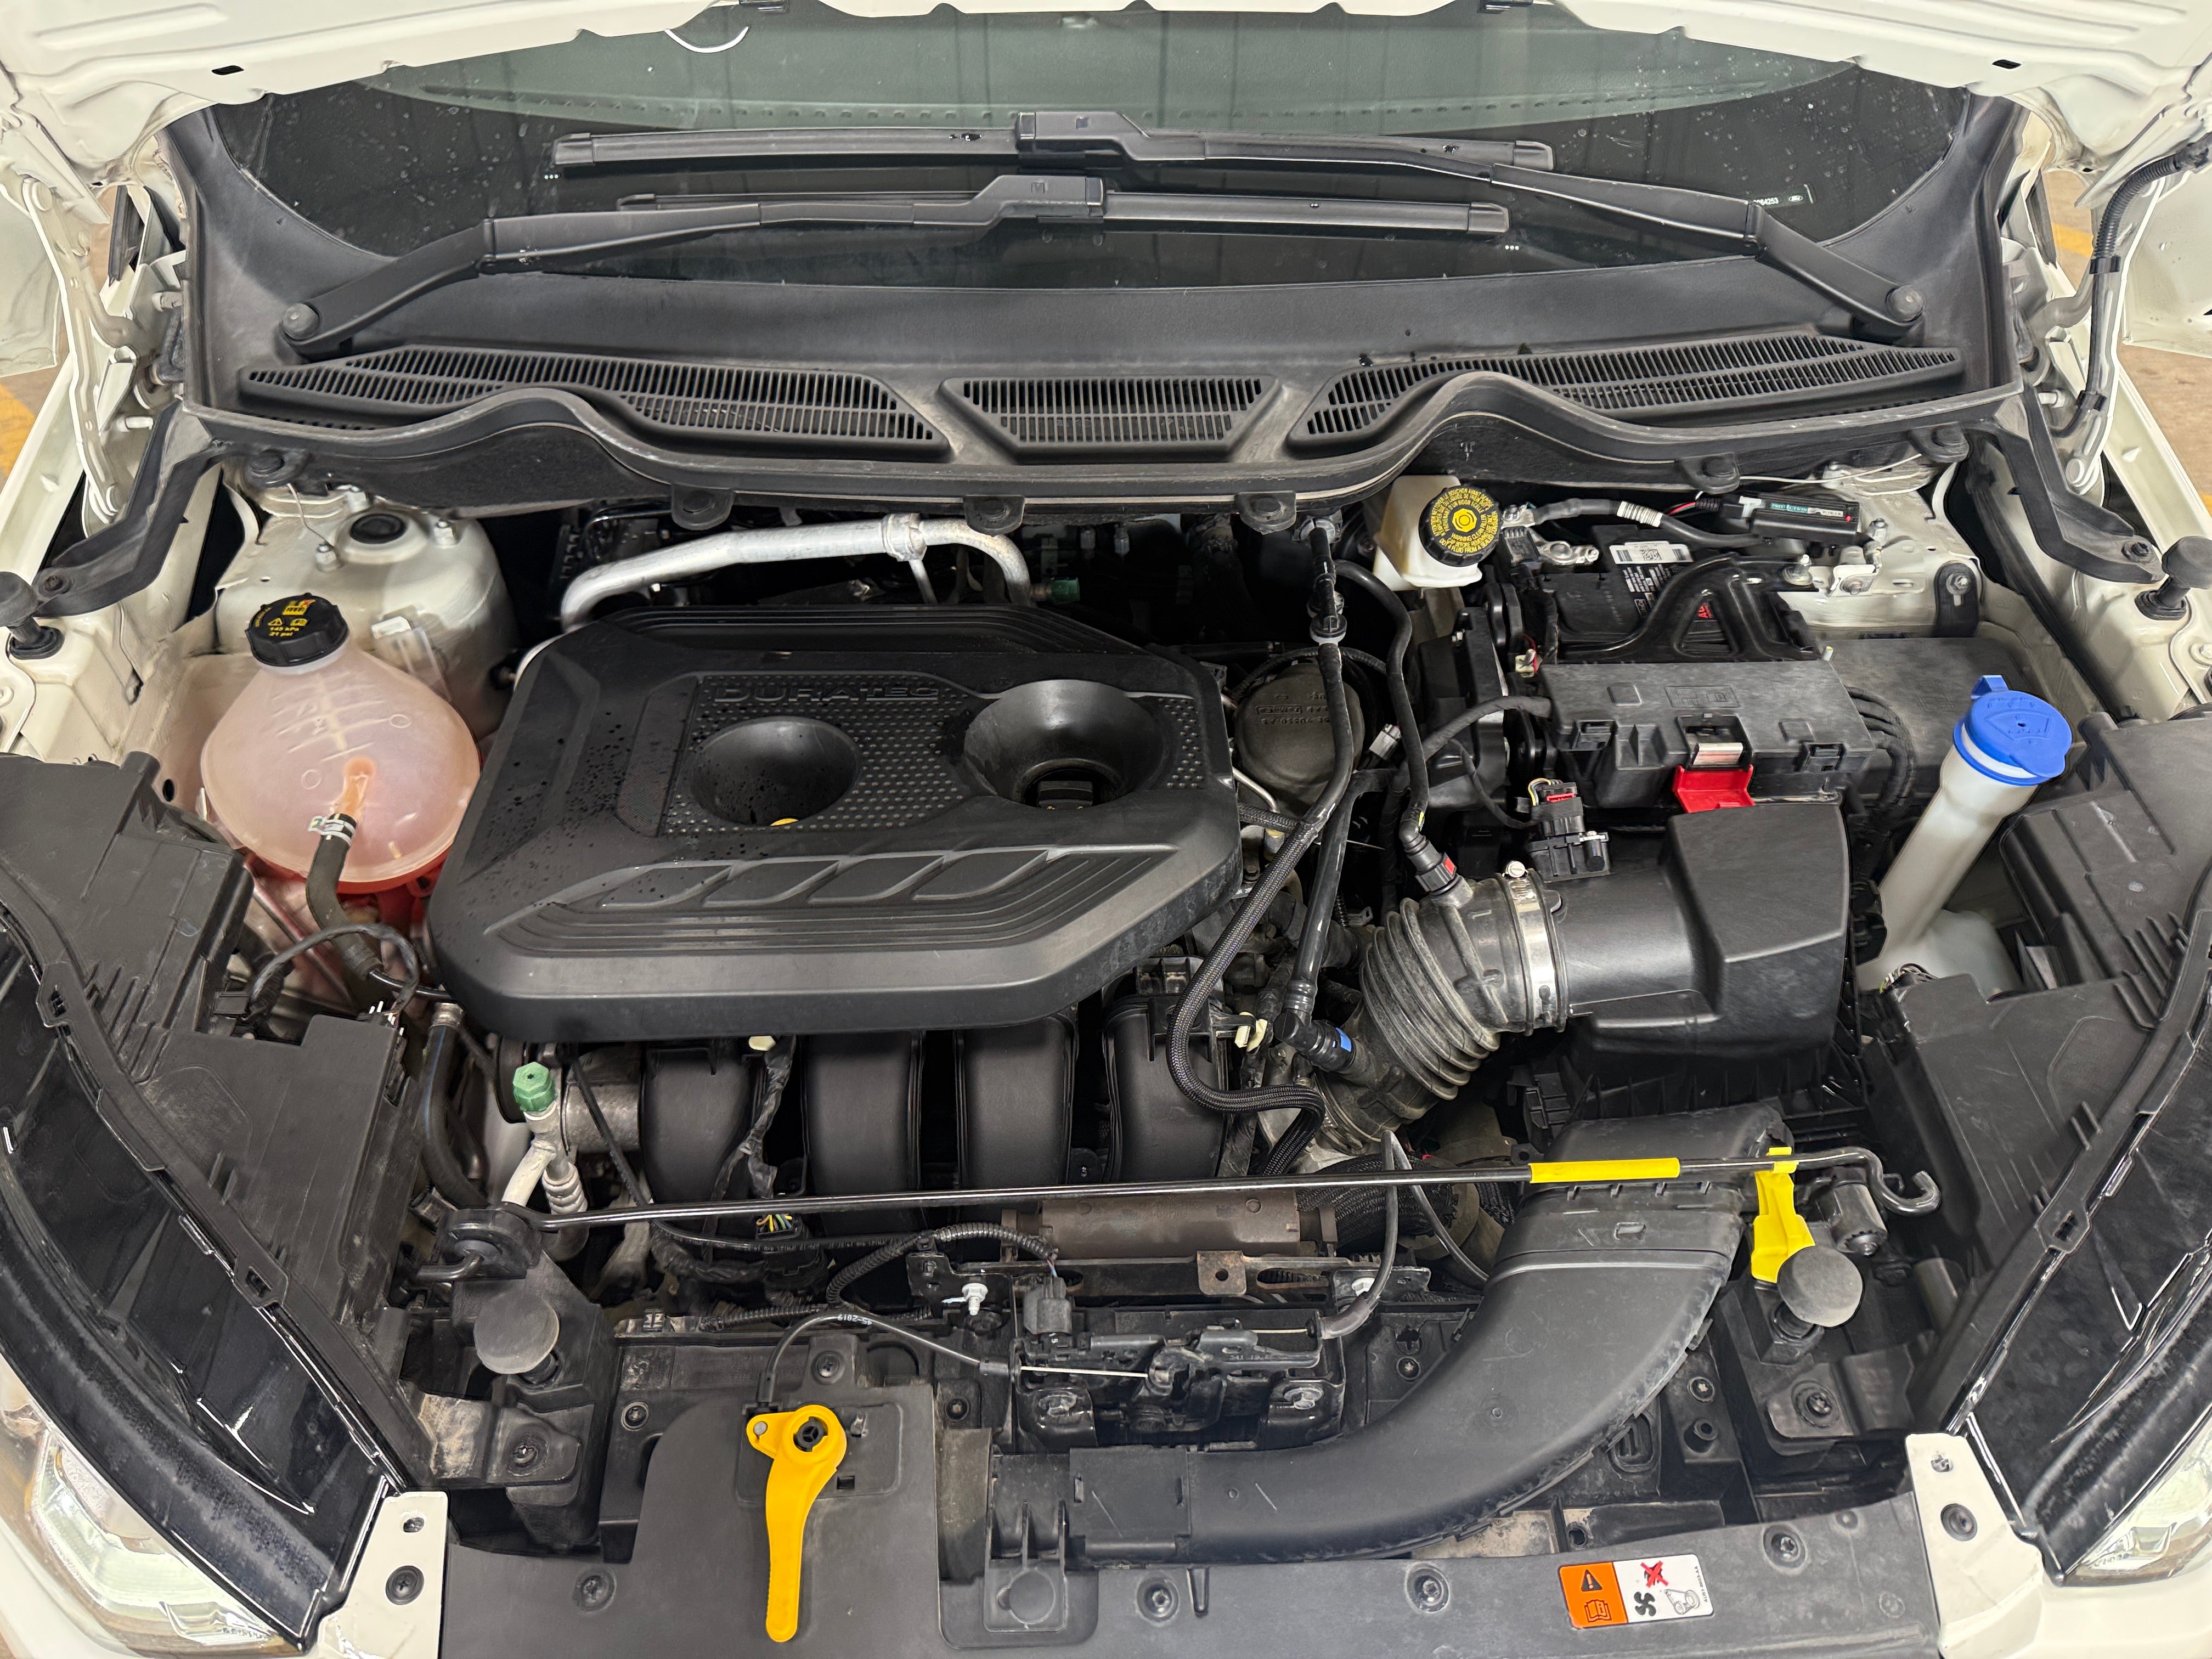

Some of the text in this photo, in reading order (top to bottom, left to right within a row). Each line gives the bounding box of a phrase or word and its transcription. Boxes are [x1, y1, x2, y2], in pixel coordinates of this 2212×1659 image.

[1451, 533, 1472, 541] WARNING
[1472, 528, 1484, 539] CLEAN
[1480, 535, 1494, 548] SEALED
[714, 686, 939, 702] DURATEC
